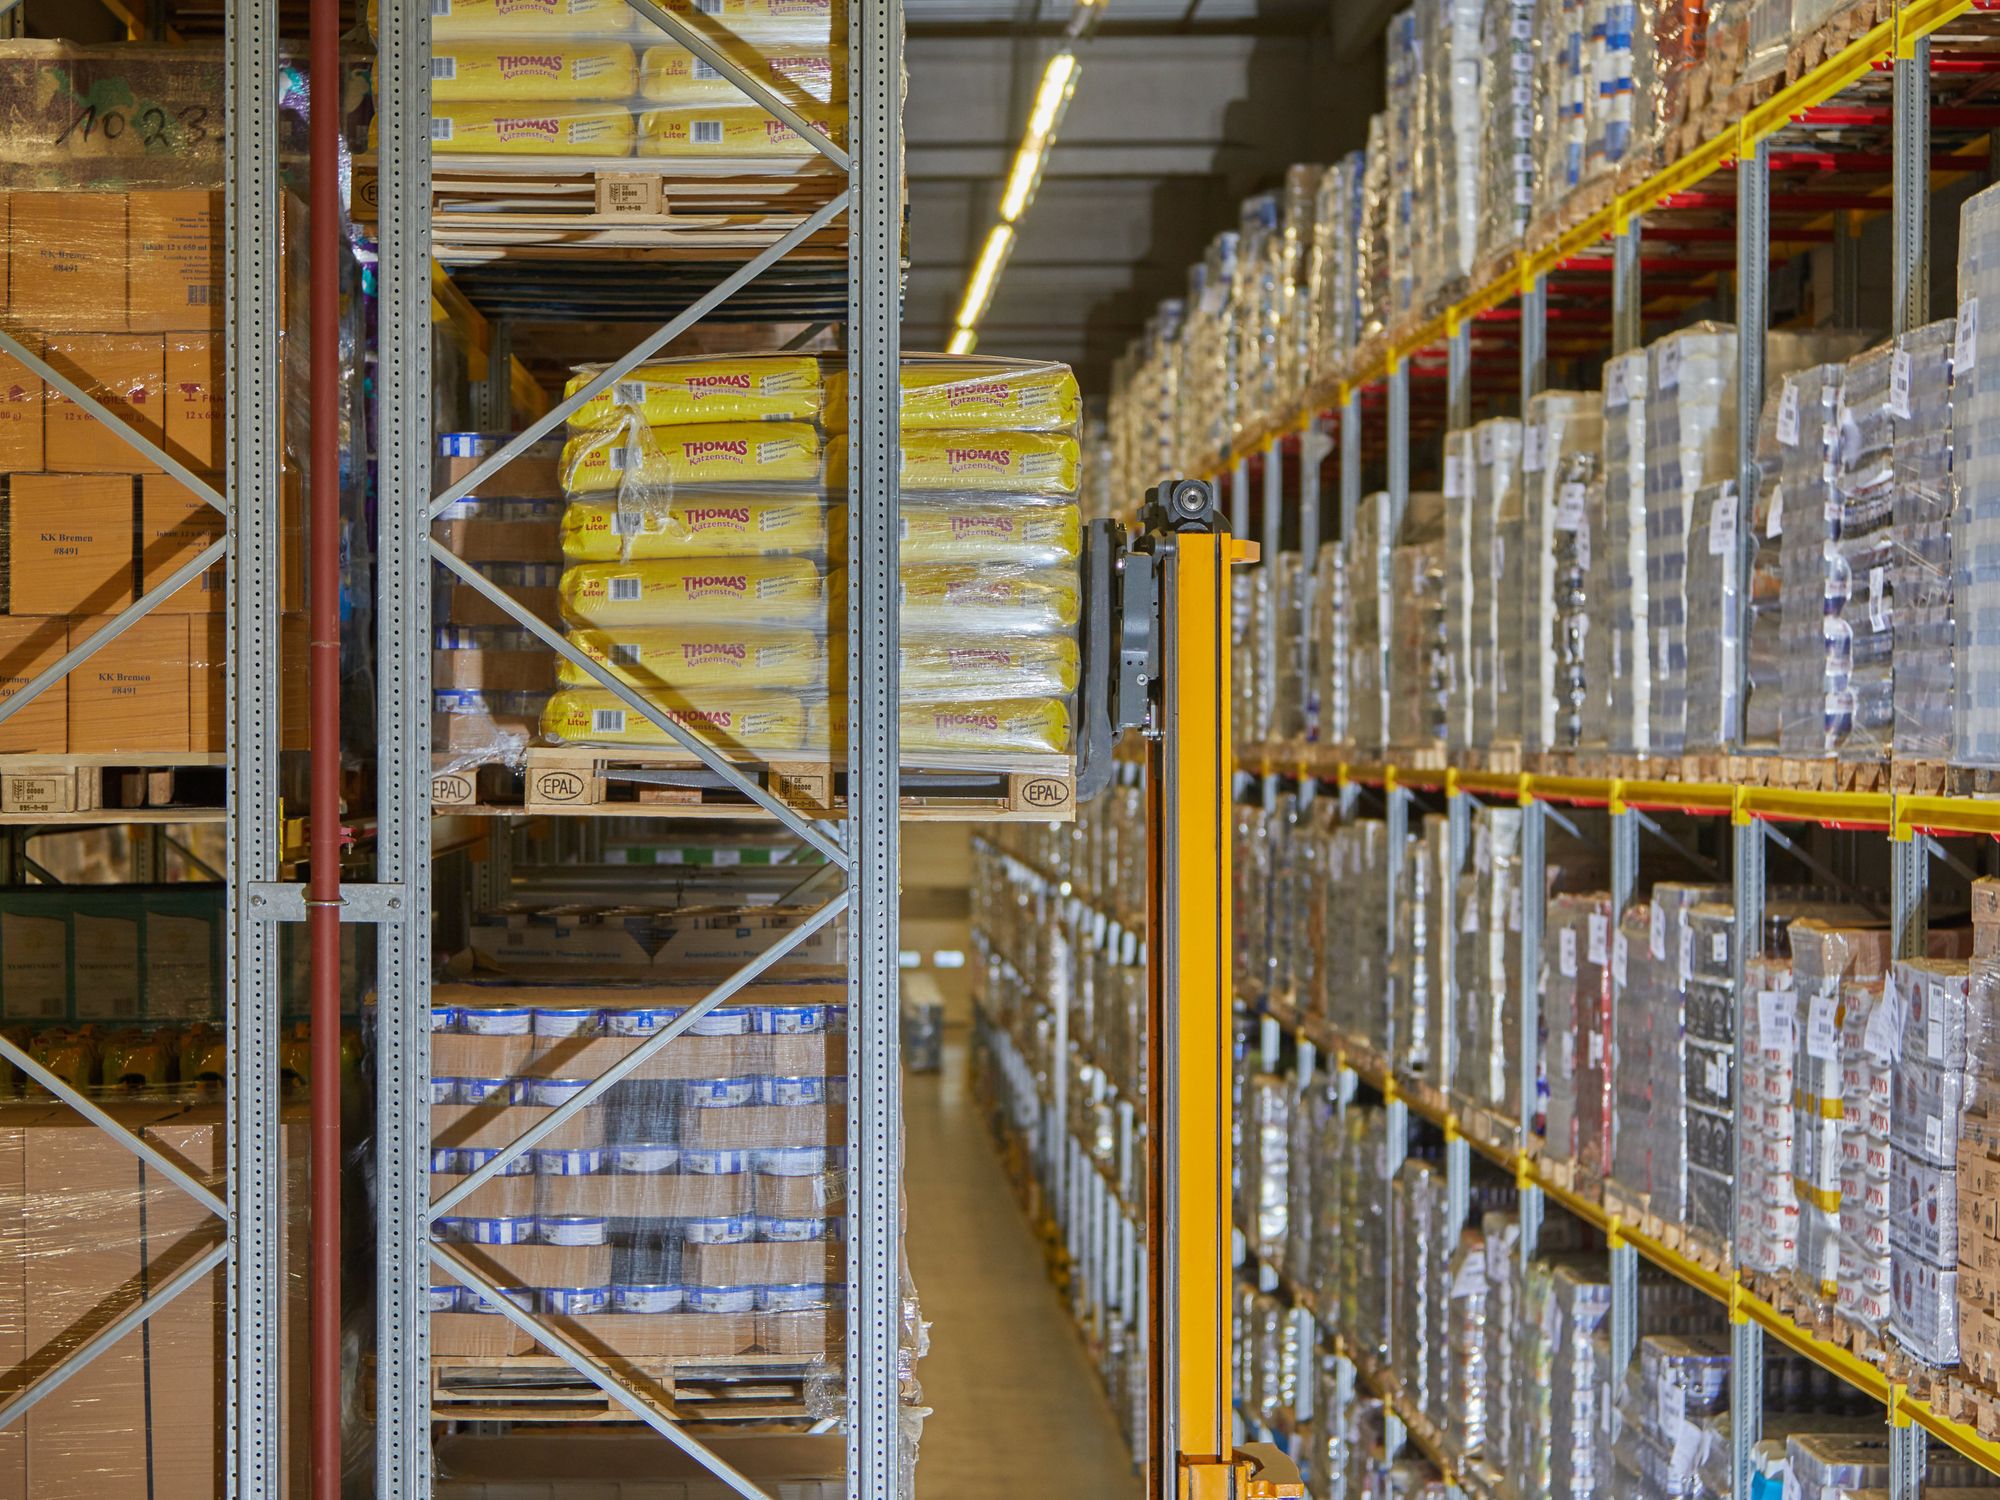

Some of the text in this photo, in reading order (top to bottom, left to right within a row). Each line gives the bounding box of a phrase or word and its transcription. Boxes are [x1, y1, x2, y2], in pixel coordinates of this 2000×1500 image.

[499, 4, 554, 15] Katzenstreu
[497, 56, 562, 71] THOMAS
[672, 60, 682, 68] 30
[503, 68, 558, 80] Katzenstreu
[666, 68, 688, 76] Liter
[55, 104, 226, 146] 1023
[494, 118, 559, 134] THOMAS
[669, 123, 681, 131] 30
[500, 131, 555, 144] Katzenstreu
[664, 131, 687, 139] Liter
[685, 374, 750, 391] THOMAS
[692, 388, 747, 400] Katzenstreu
[946, 383, 1009, 399] THOMAS
[950, 396, 1004, 408] Katzenstreu
[65, 412, 75, 420] 12
[186, 411, 196, 420] 12
[683, 440, 747, 456] THOMAS
[590, 451, 600, 459] 30
[689, 453, 744, 466] Katzenstreu
[946, 449, 1010, 465] THOMAS
[585, 458, 606, 467] Liter
[952, 462, 1006, 474] Katzenstreu
[591, 515, 602, 523] 30
[685, 508, 749, 525] THOMAS
[585, 522, 608, 531] Liter
[691, 520, 746, 533] Katzenstreu
[950, 516, 1013, 532] THOMAS
[41, 533, 93, 543] KK Bremen
[955, 529, 1009, 541] Katzenstreu
[54, 547, 79, 556] #8491
[588, 581, 600, 589] 30
[682, 576, 747, 592] THOMAS
[583, 588, 605, 597] Liter
[688, 588, 742, 600] Katzenstreu
[681, 643, 746, 659] THOMAS
[687, 656, 742, 668] Katzenstreu
[0, 675, 30, 683] remen
[99, 673, 150, 681] KK Bremen
[112, 687, 136, 695] #8491
[567, 718, 589, 727] Liter
[666, 710, 731, 727] THOMAS
[934, 715, 997, 730] THOMAS
[432, 781, 464, 799] EPAL
[544, 779, 577, 794] EPAL
[1030, 785, 1062, 801] EPAL
